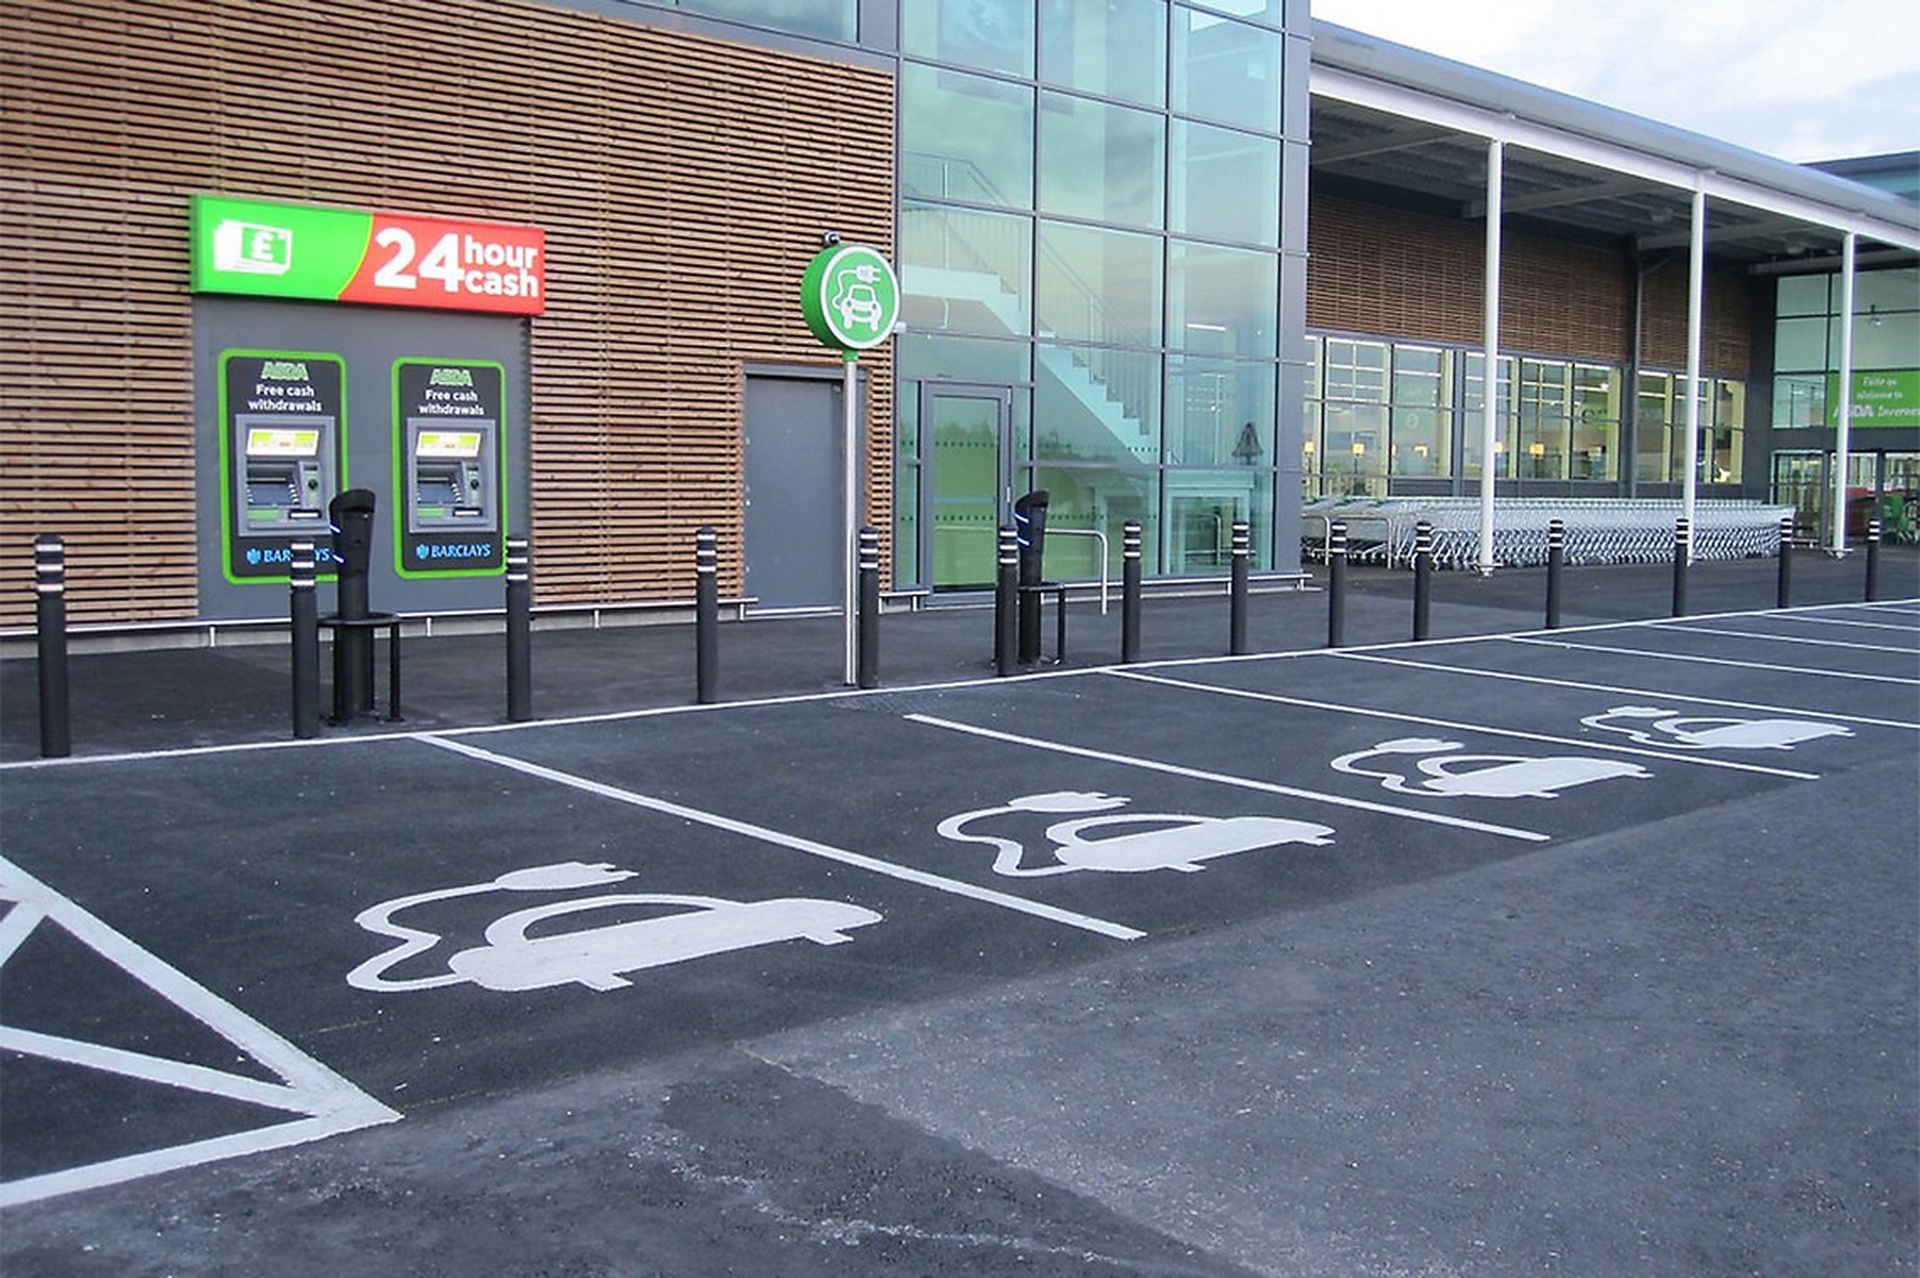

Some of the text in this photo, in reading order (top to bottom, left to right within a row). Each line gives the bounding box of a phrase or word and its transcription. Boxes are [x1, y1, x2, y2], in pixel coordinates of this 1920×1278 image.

[374, 227, 538, 292] 24 hour
[465, 268, 538, 298] cash
[256, 383, 315, 397] Free cash
[425, 389, 478, 402] Free cash
[248, 398, 322, 411] withdrawals
[418, 402, 484, 415] withdrawals
[264, 548, 330, 563] BARYS
[431, 544, 491, 558] BARCLAYS
